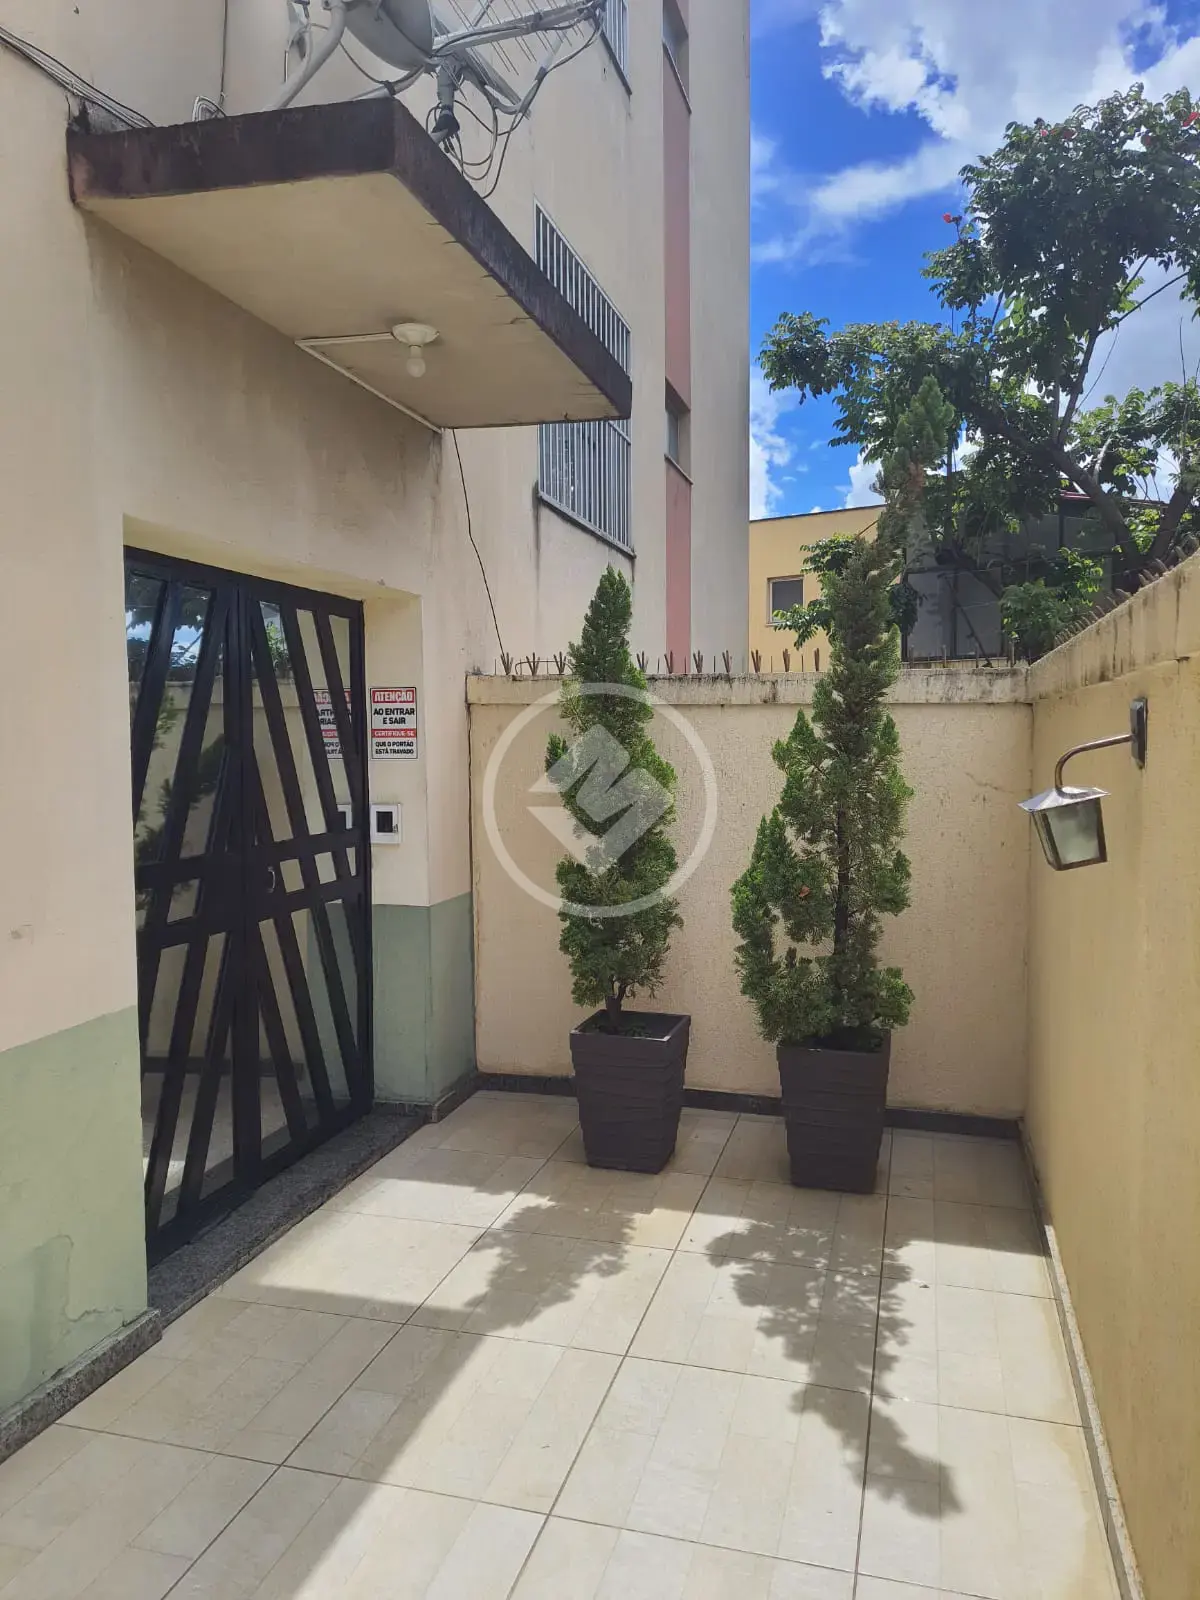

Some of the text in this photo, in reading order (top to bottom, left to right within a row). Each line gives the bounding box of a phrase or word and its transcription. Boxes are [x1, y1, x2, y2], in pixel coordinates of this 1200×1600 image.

[374, 690, 413, 702] ATENÇÃO
[373, 708, 415, 716] AO ENTRAR
[383, 717, 406, 725] E SAIR
[375, 747, 389, 755] ESTÁ
